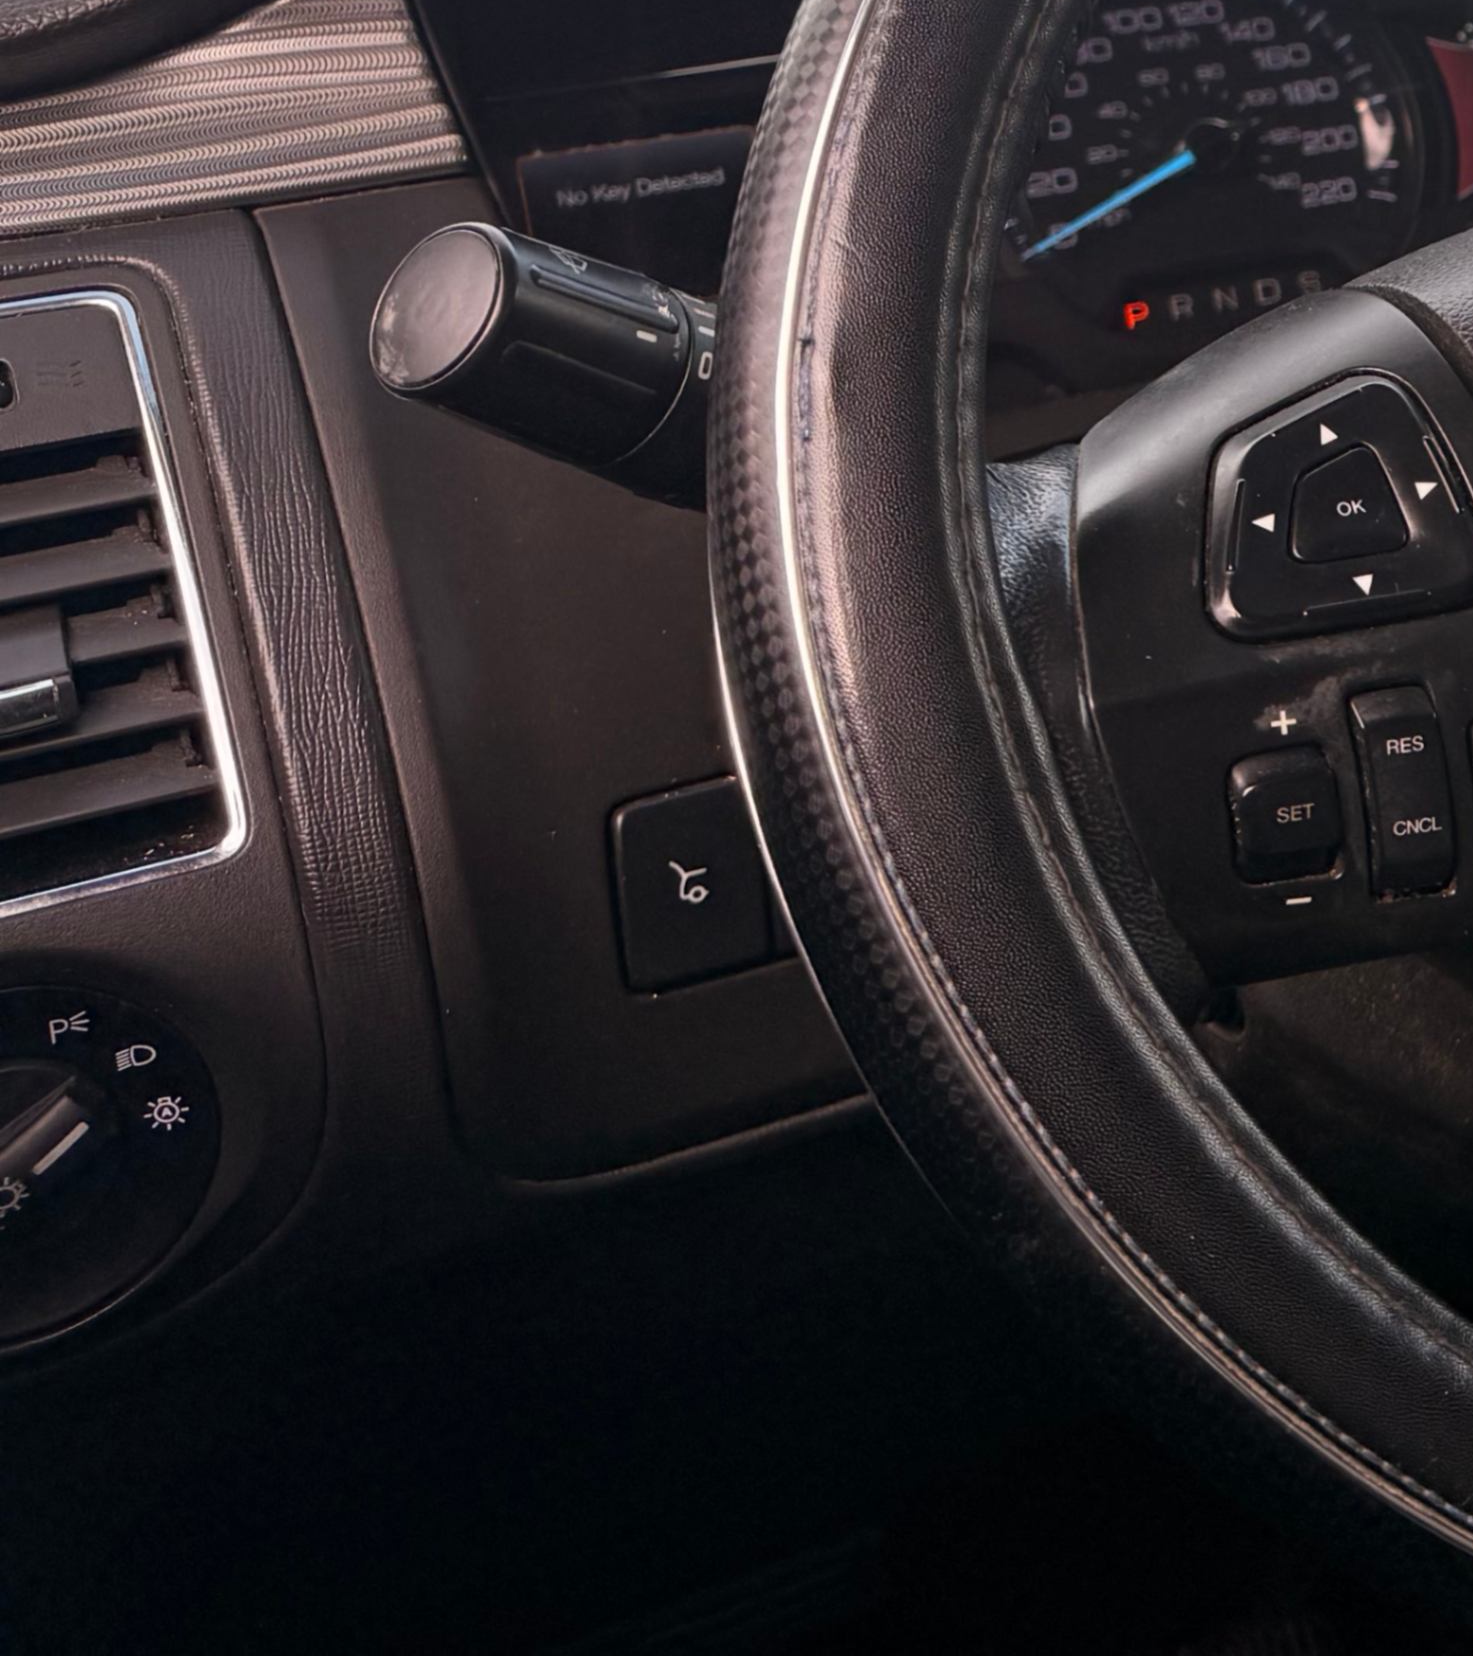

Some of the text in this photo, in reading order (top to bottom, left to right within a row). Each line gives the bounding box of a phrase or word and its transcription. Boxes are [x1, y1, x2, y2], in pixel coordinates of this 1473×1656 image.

[1101, 6, 1163, 35] 100
[1219, 16, 1276, 44] 140
[1252, 41, 1313, 72] 160
[1281, 75, 1340, 107] 180
[1300, 123, 1359, 157] 200
[555, 164, 727, 208] No Key Detected
[1027, 167, 1079, 200] 20
[1300, 175, 1358, 209] 220
[1121, 299, 1152, 331] P
[1167, 291, 1195, 322] R
[1210, 284, 1241, 312] N
[1252, 276, 1283, 306] D
[1335, 497, 1367, 518] OK
[1384, 735, 1426, 757] RES
[1275, 802, 1316, 824] SET
[1391, 815, 1444, 837] CNCL
